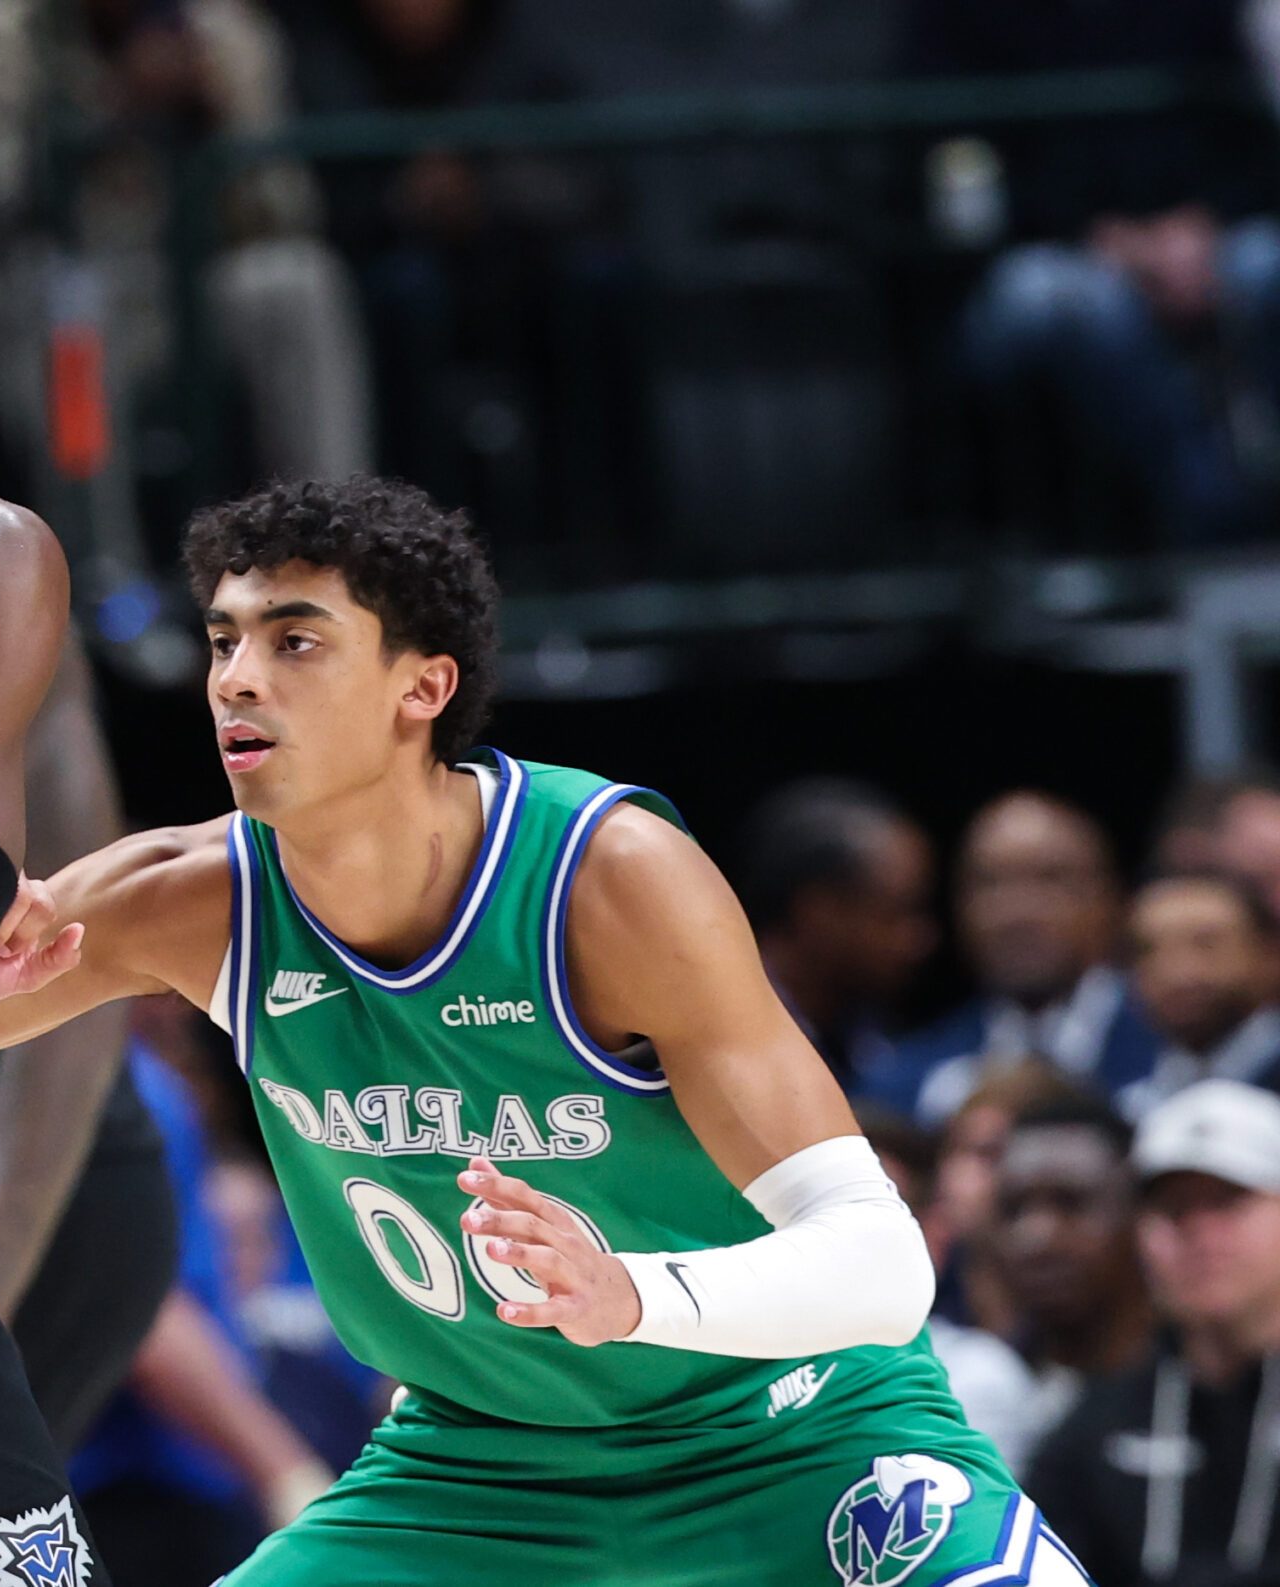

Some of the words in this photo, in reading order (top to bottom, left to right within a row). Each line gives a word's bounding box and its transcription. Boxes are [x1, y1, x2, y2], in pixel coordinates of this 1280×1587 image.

[270, 970, 327, 1000] NIKE
[441, 995, 536, 1027] chime
[258, 1077, 612, 1160] DALLAS
[767, 1363, 818, 1413] NIKE
